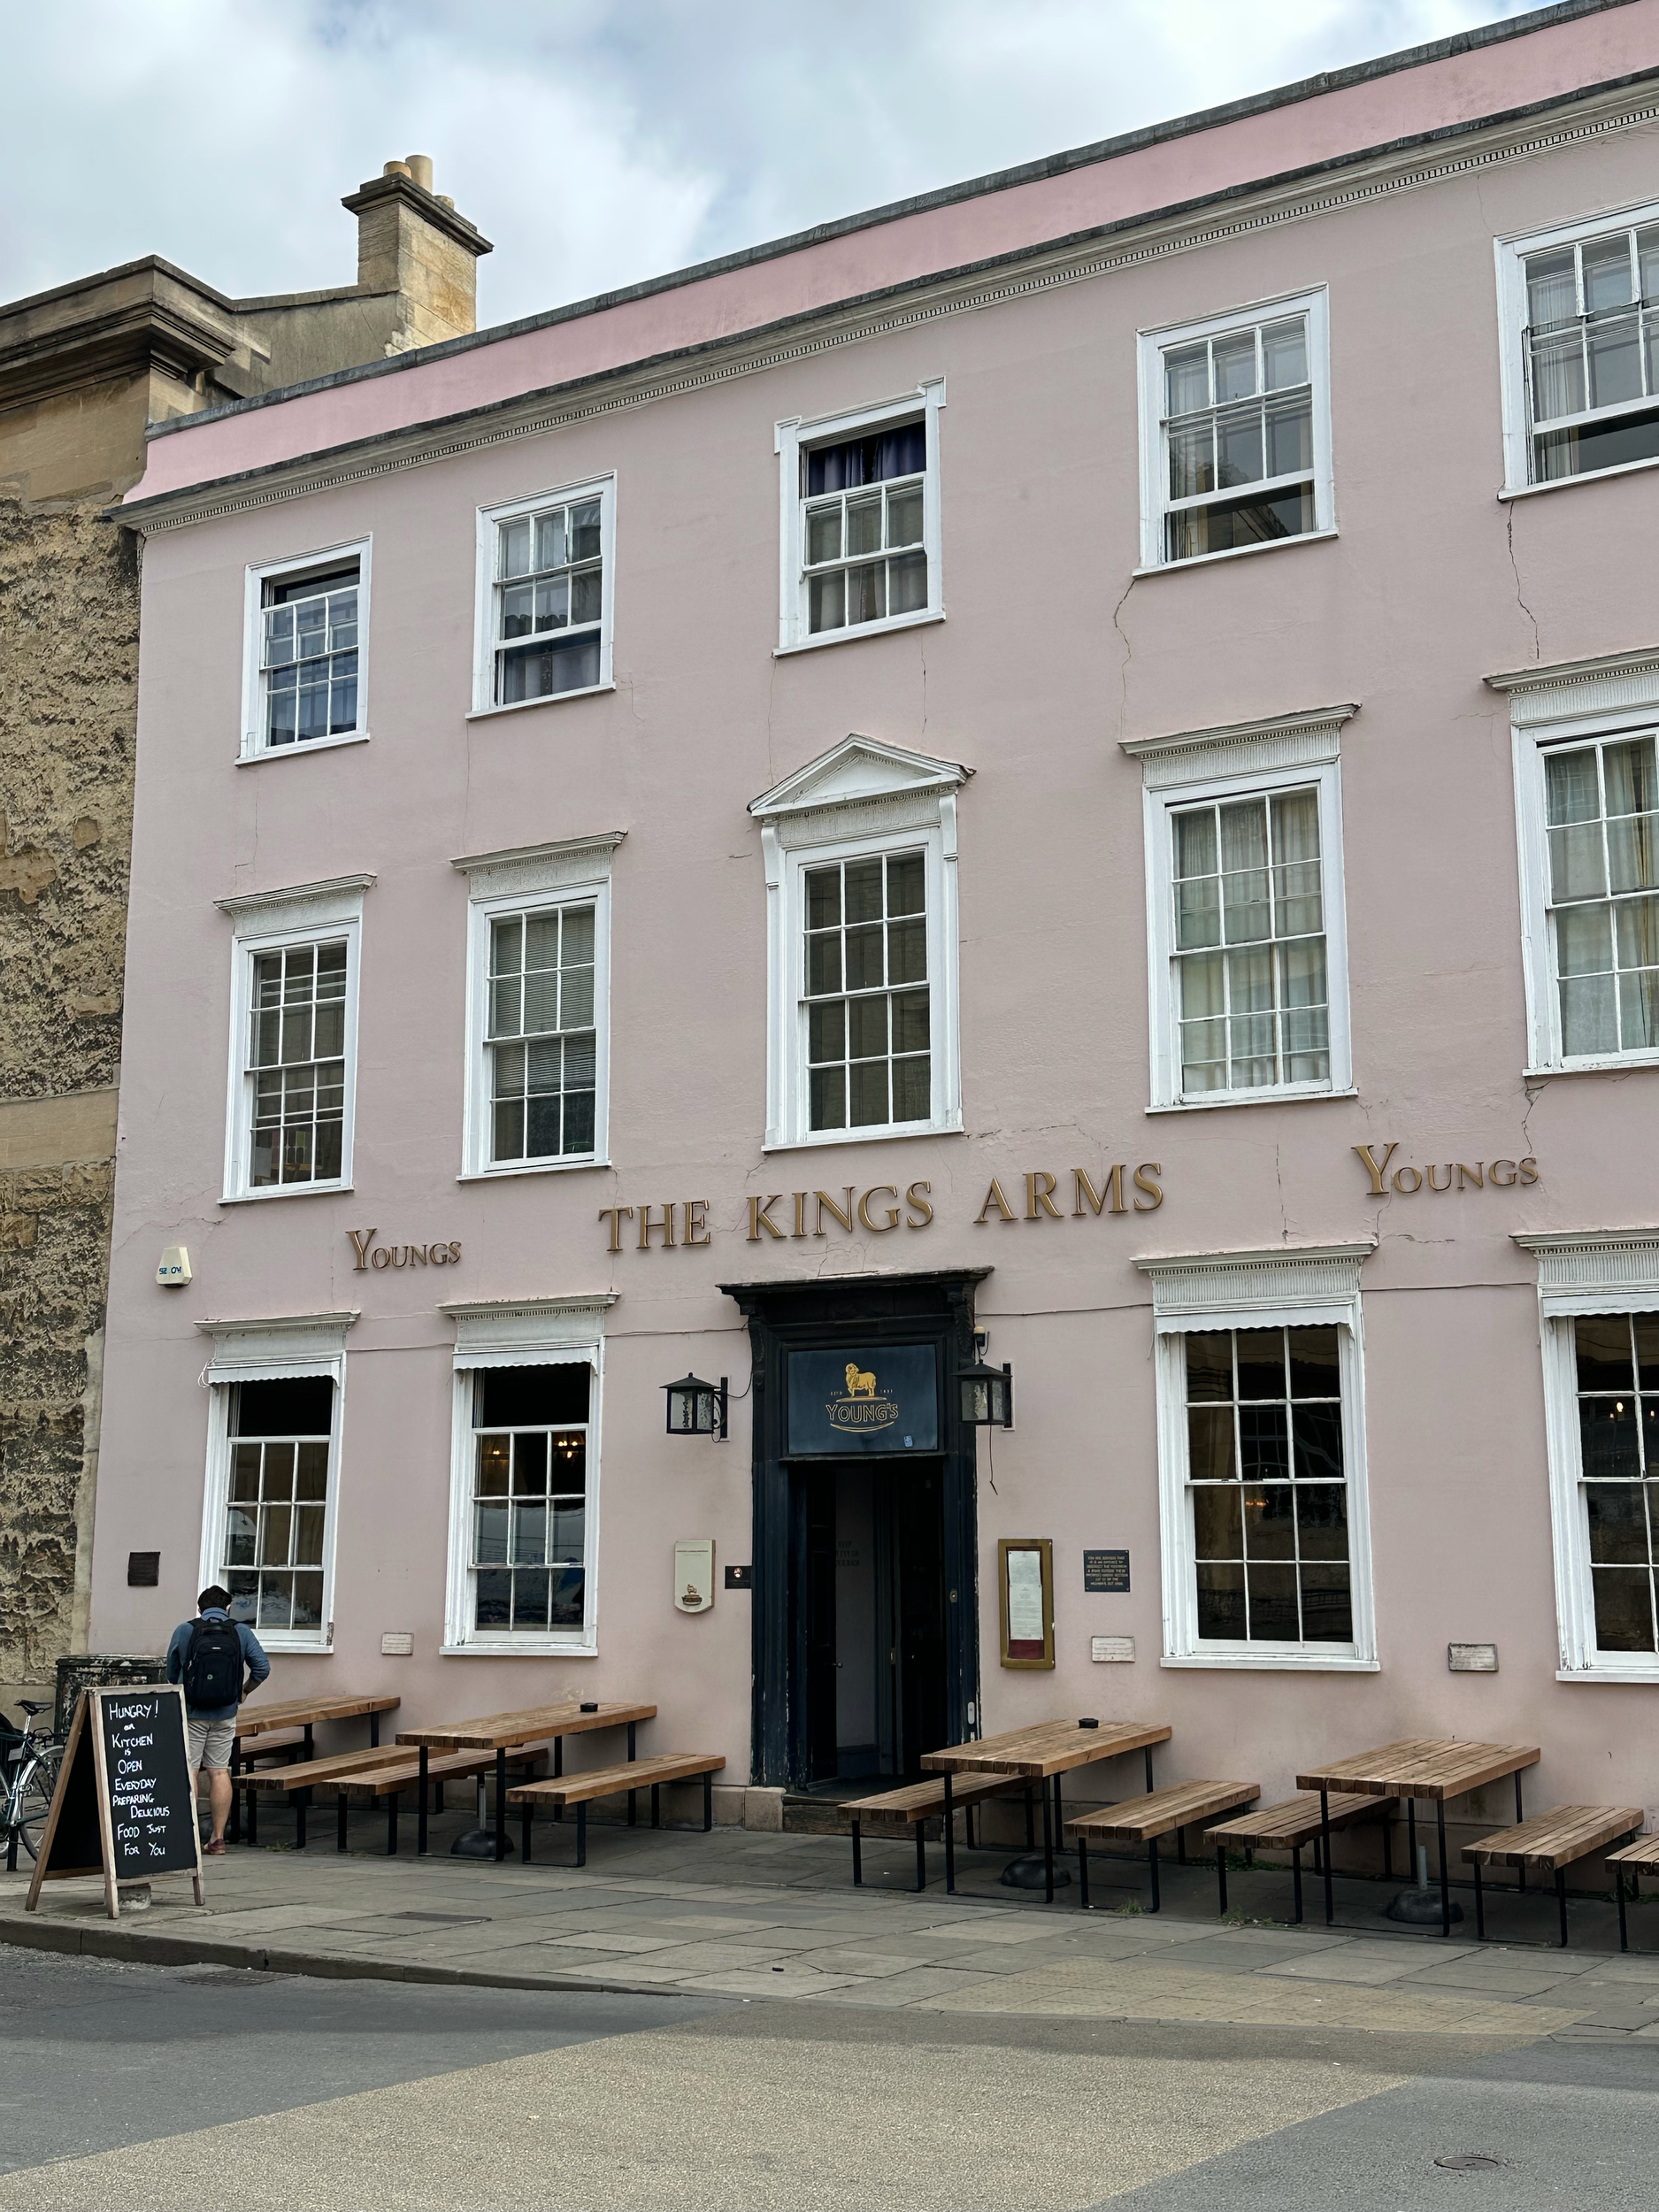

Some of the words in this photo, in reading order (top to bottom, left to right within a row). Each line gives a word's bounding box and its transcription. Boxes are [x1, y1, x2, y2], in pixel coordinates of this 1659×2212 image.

[598, 1199, 711, 1252] THE
[745, 1181, 933, 1241] KINGS
[972, 1162, 1164, 1223] ARMS
[826, 1402, 899, 1423] YOUNG'S
[111, 1732, 153, 1748] KITCHEN
[118, 1759, 142, 1775] OPEN
[115, 1778, 157, 1791] EVERYDAY
[112, 1793, 155, 1807] PREPARING
[130, 1805, 171, 1819] DELICIOUS
[117, 1823, 140, 1840] FOOD
[146, 1824, 166, 1834] JUST
[124, 1842, 140, 1856] FOR
[149, 1842, 165, 1856] YOU
